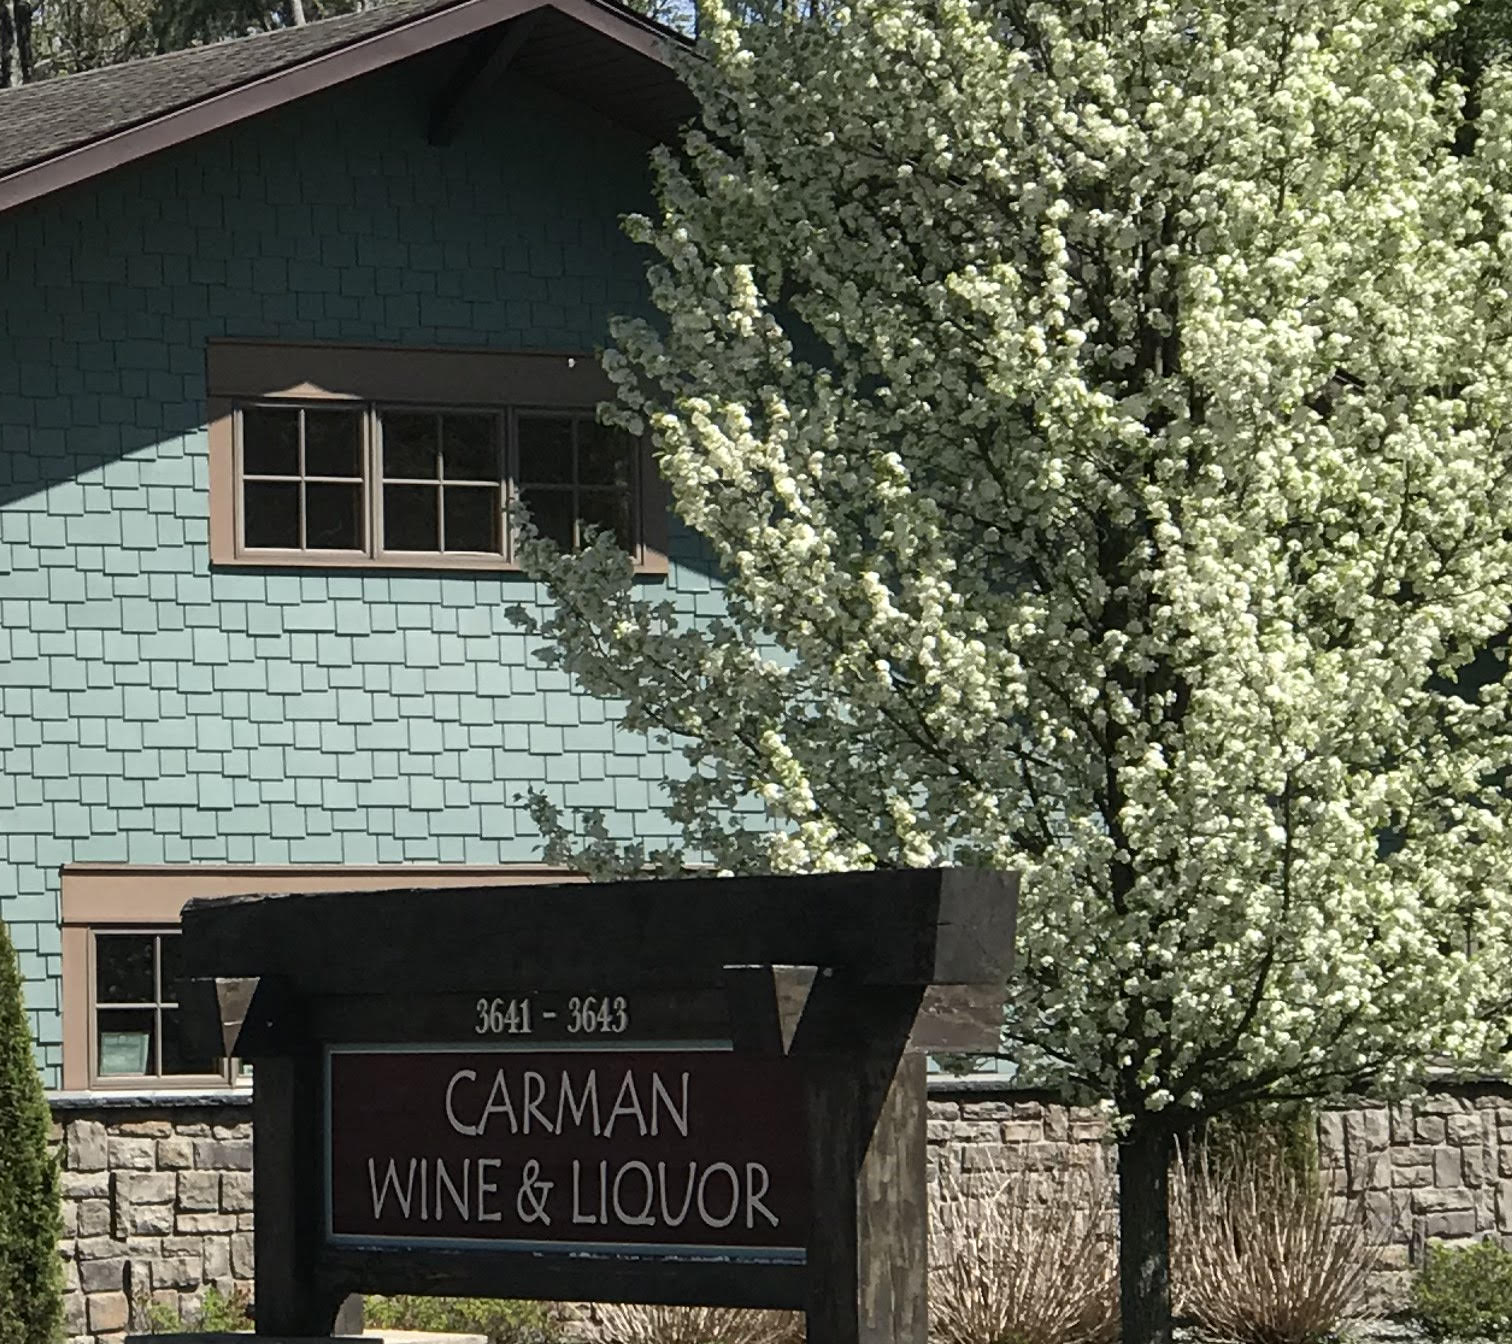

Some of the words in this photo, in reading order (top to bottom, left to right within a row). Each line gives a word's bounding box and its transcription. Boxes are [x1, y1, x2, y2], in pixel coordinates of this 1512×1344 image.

[474, 996, 532, 1035] 3641
[567, 995, 629, 1034] 3643
[444, 1067, 691, 1139] CARMAN
[367, 1156, 503, 1223] WINE
[516, 1158, 555, 1227] &
[571, 1158, 781, 1230] LIQUOR
